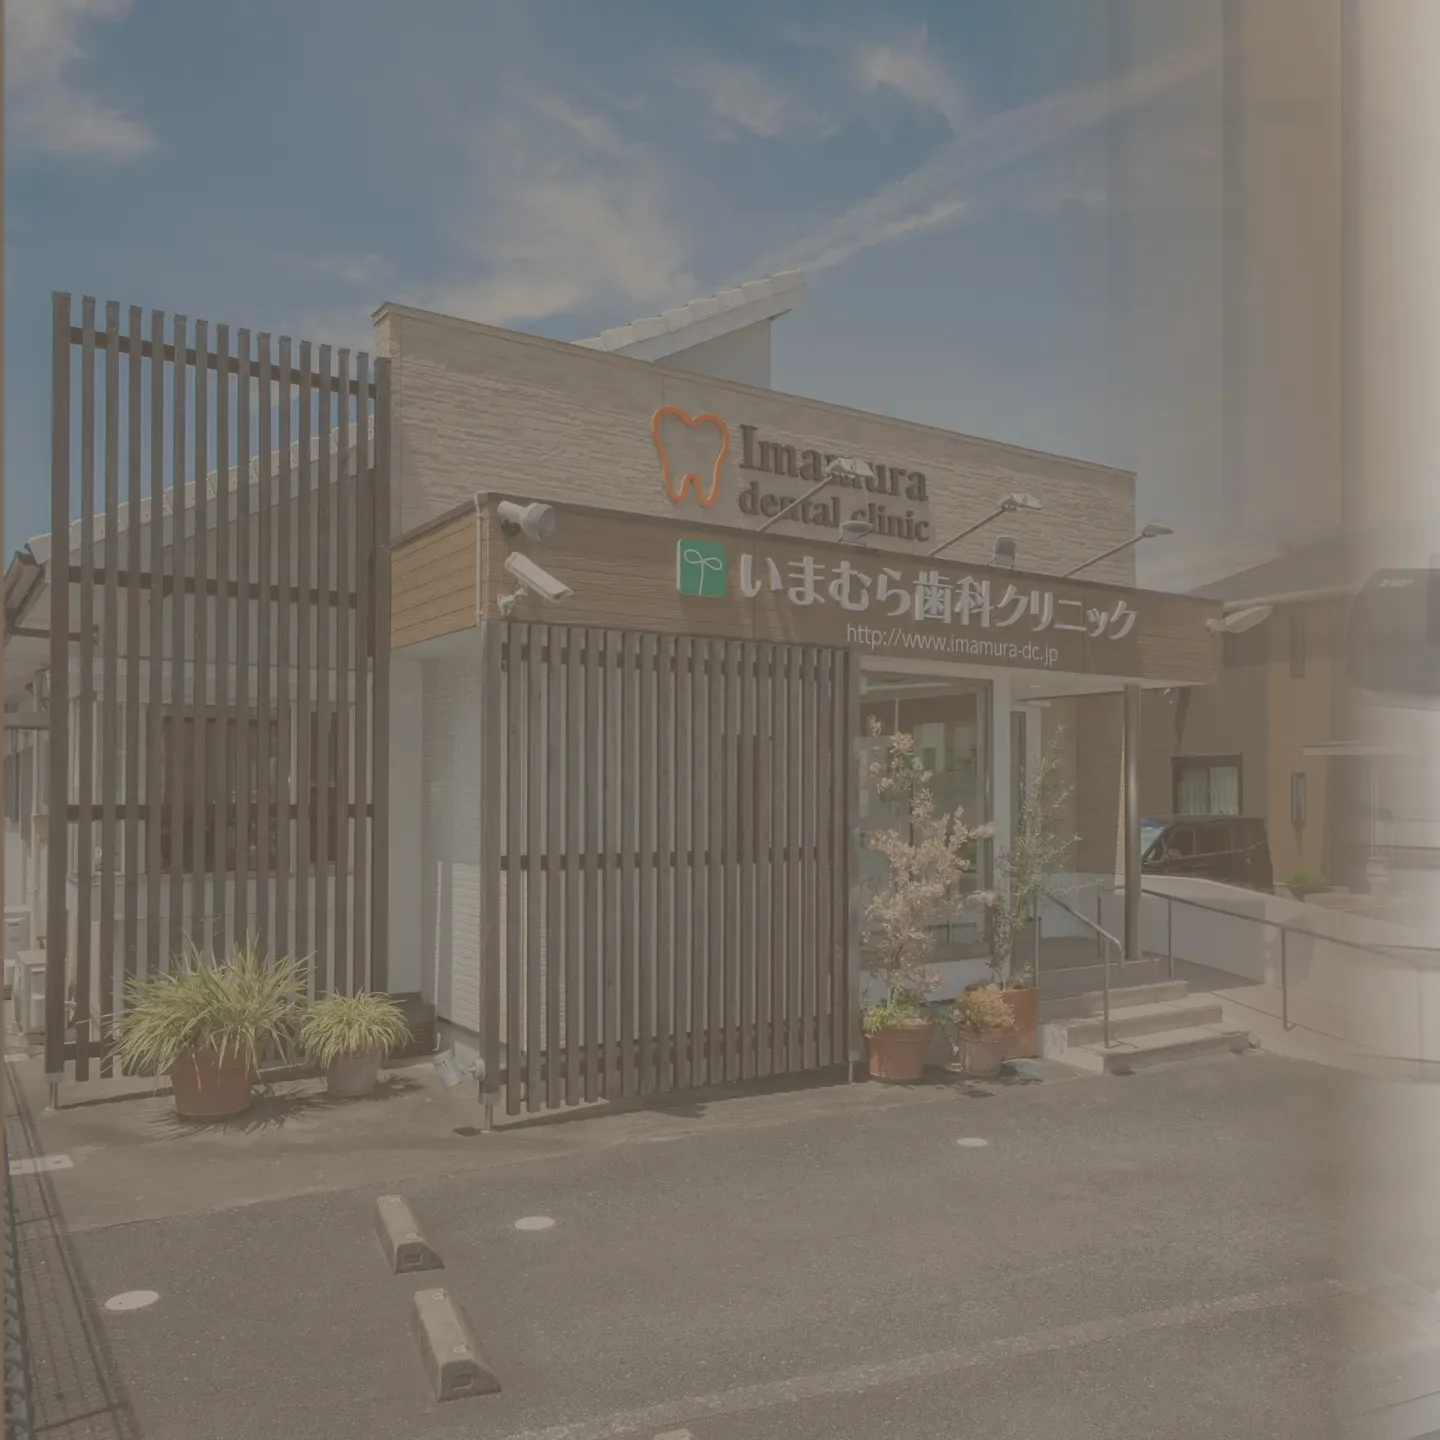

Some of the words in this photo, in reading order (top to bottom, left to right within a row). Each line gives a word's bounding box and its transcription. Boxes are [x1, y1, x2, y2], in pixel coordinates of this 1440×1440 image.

[738, 481, 840, 528] dental
[740, 553, 1138, 640] いまむら歯科クリニック
[846, 622, 1059, 666] http://www.imamura-dc.jp
